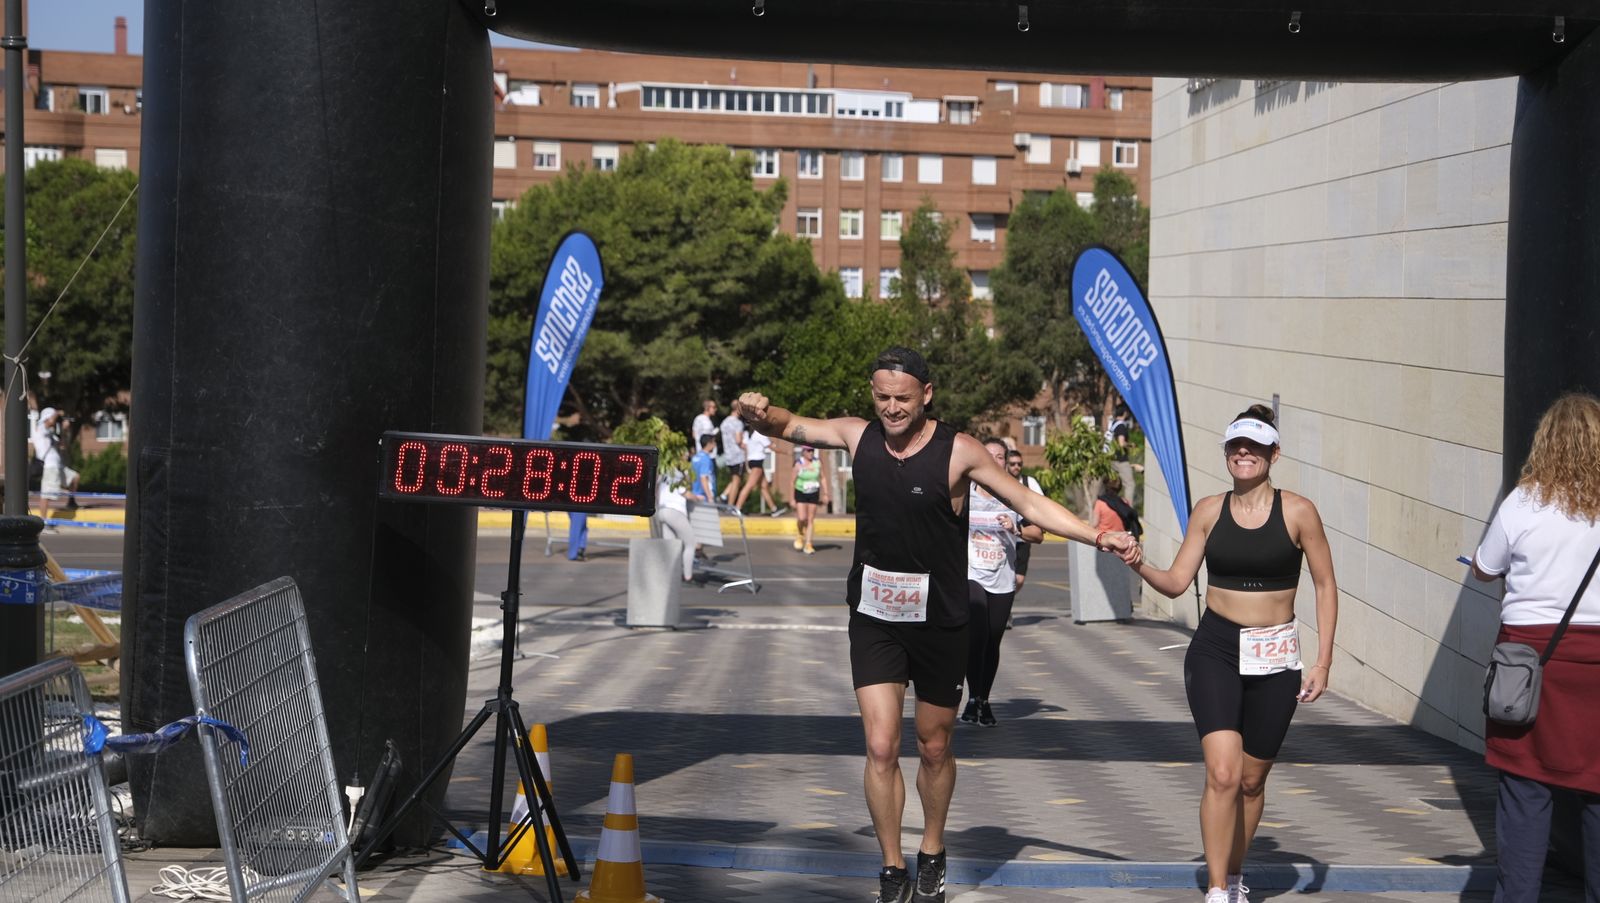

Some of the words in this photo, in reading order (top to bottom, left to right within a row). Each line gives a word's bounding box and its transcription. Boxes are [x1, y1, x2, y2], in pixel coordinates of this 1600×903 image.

[395, 442, 643, 505] 00:28:02
[975, 549, 1004, 560] 1085
[871, 586, 921, 605] 1244
[1251, 637, 1297, 657] 1243
